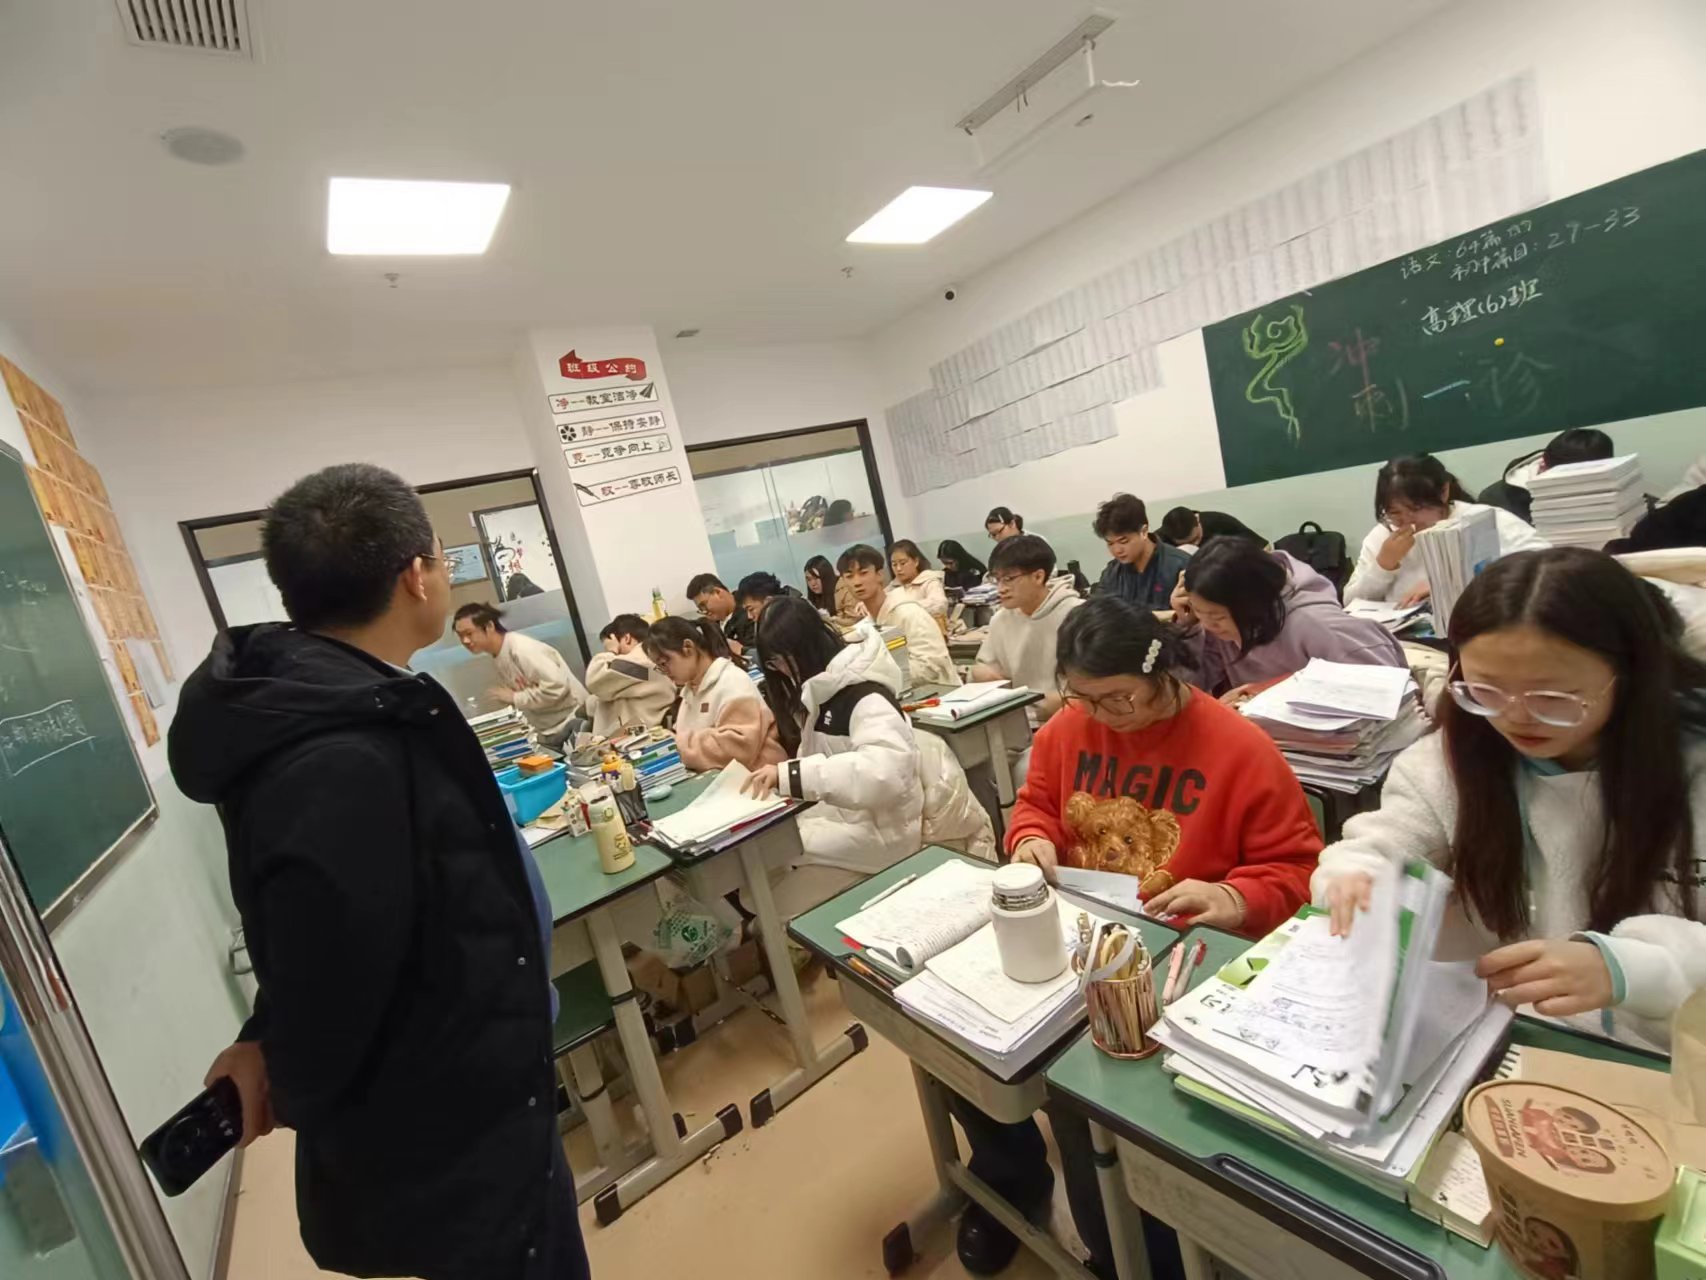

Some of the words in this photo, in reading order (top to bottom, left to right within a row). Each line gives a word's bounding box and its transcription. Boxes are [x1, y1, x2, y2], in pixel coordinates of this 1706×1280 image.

[567, 363, 637, 374] 班级公约
[1073, 749, 1207, 817] MAGIC
